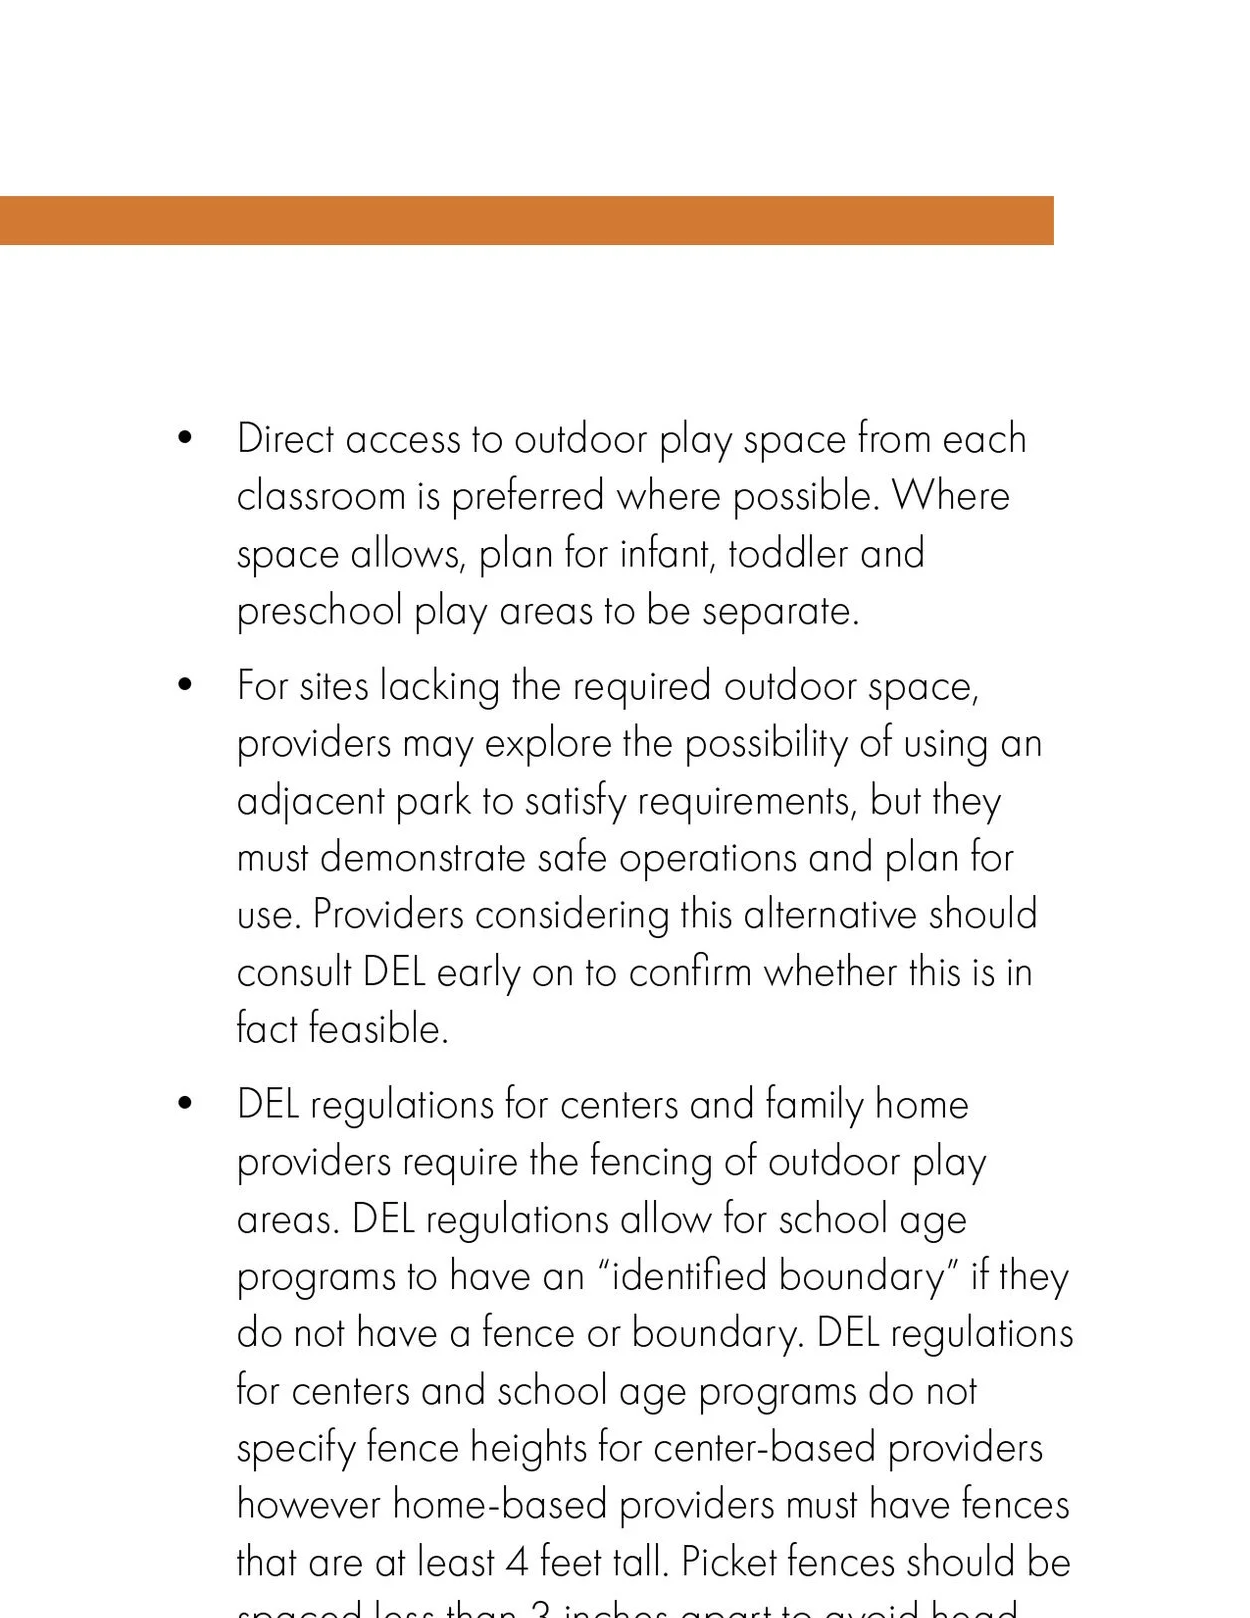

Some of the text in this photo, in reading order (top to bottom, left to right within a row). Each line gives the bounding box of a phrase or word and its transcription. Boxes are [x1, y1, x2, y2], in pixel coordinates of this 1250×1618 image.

[237, 474, 1010, 521] classroom is preferred where possible. Where
[239, 665, 978, 711] For sites lacking the required outdoor space,
[237, 779, 1002, 826] adjacent park to satisfy requirements, but they
[236, 1008, 448, 1044] fact feasible.
[237, 1198, 967, 1244] areas. DEL regulations allow for school age
[237, 1426, 1043, 1473] specify fence heights for center-based providers
[236, 1541, 1071, 1577] that are at least 4 feet tall. Picket fences should be
